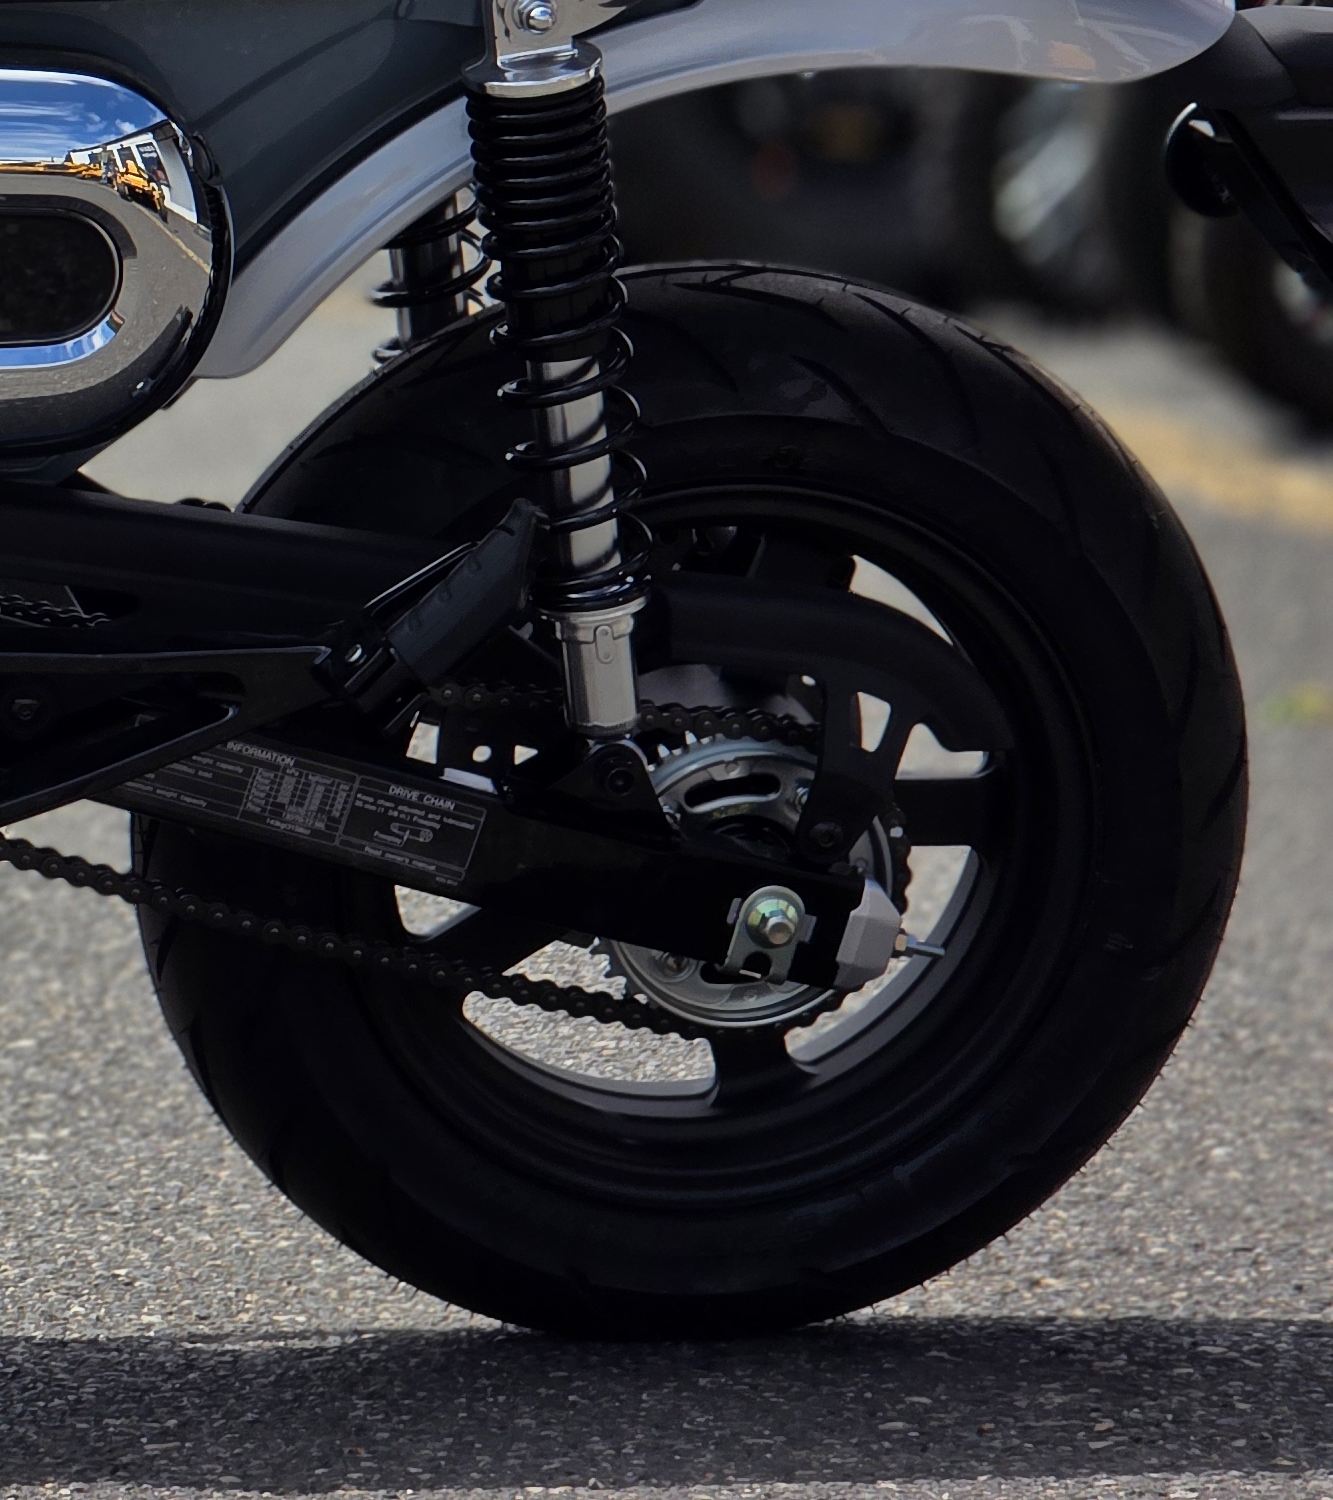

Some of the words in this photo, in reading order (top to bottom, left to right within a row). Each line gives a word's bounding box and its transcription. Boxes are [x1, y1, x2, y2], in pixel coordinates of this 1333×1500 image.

[226, 741, 296, 767] INFORMATION
[388, 784, 420, 801] DRIVE
[423, 794, 455, 811] CHAIN
